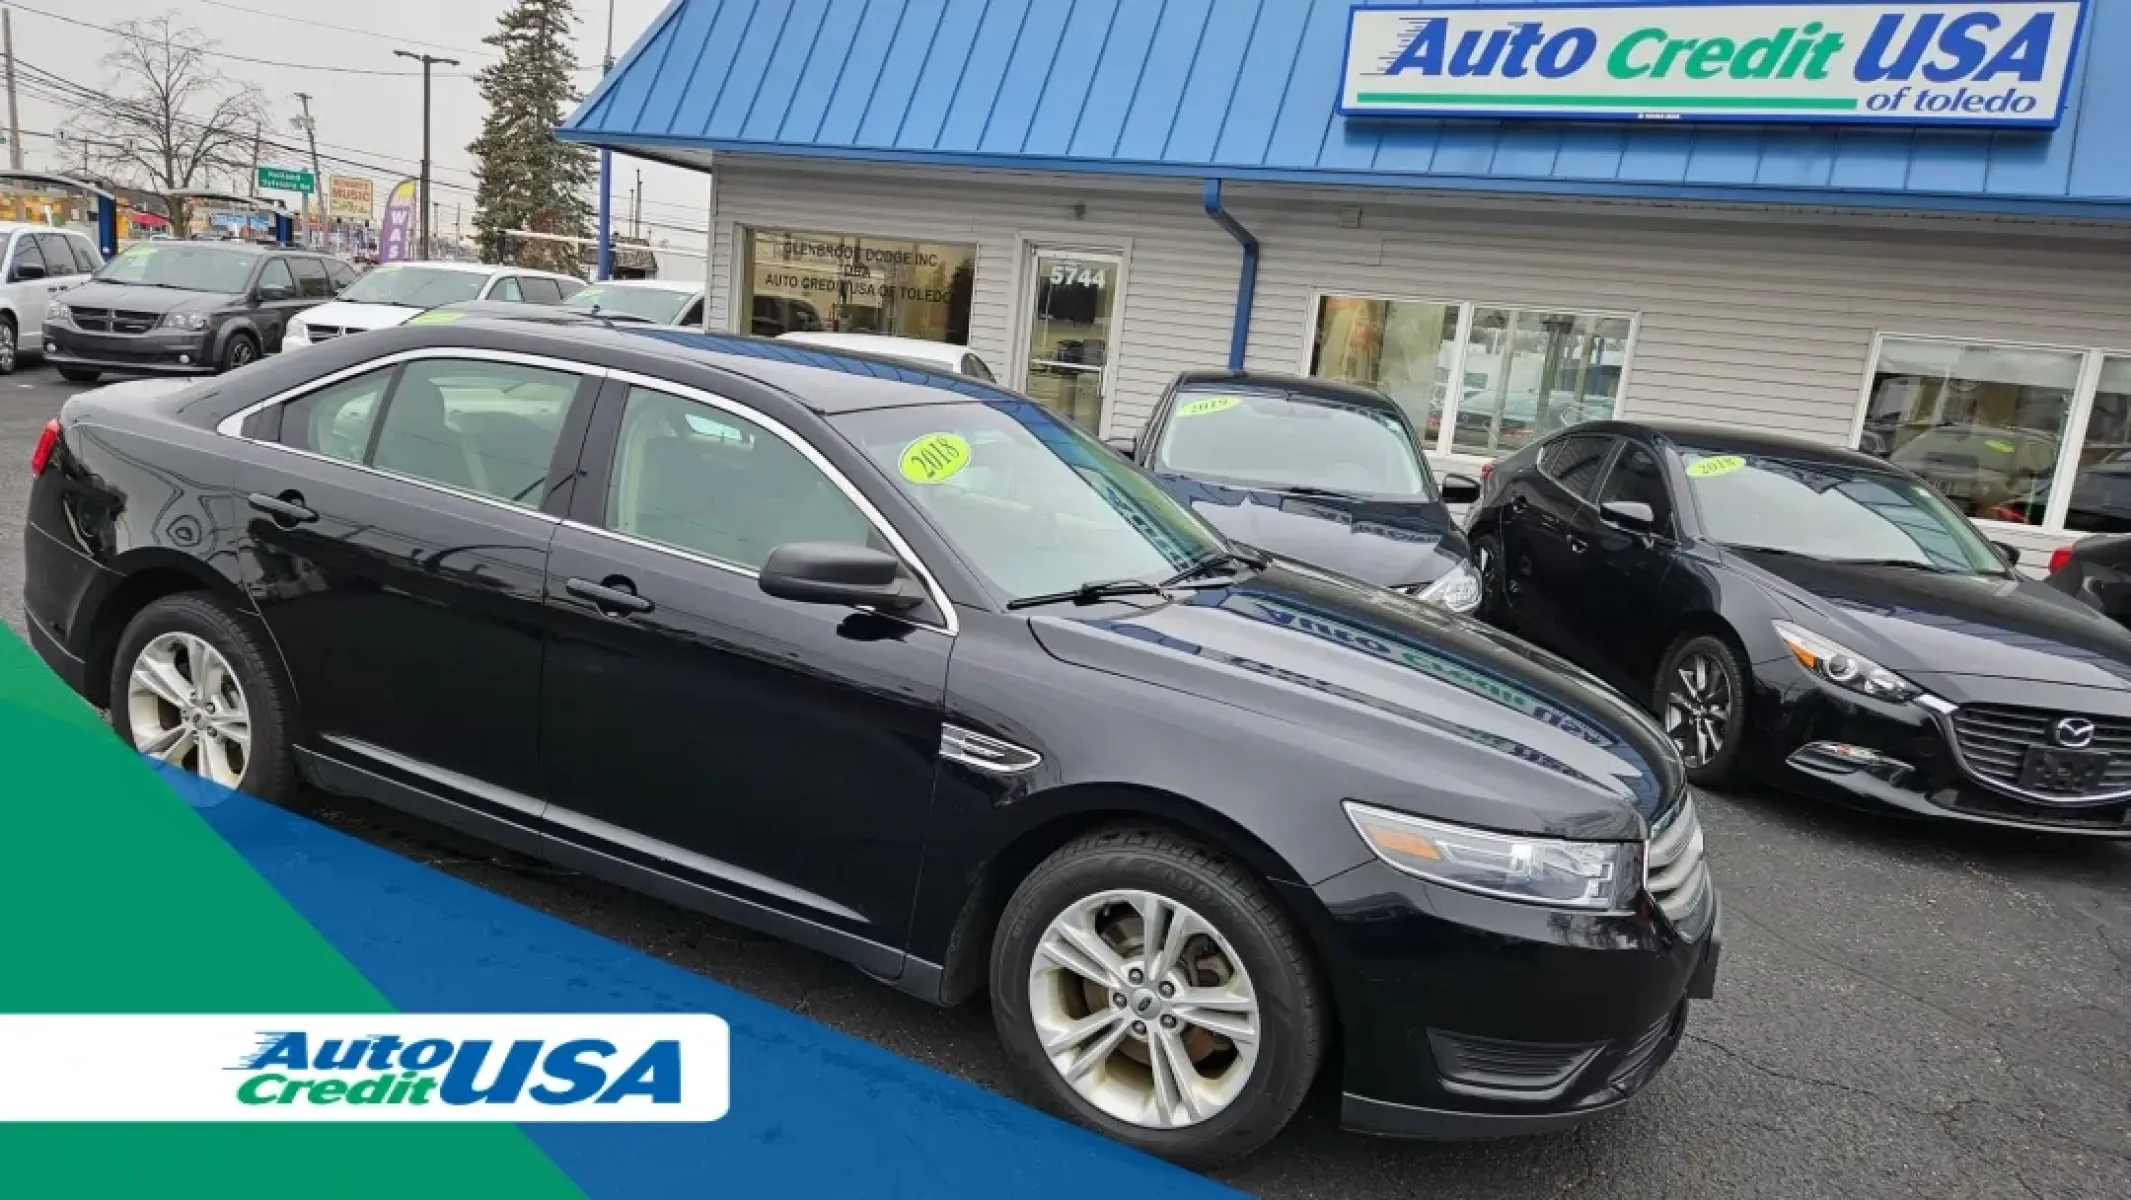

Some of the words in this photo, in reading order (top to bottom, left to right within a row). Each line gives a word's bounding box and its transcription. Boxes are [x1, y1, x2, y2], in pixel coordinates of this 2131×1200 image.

[1362, 17, 1597, 79] Auto
[1606, 20, 1845, 80] Credit
[1853, 11, 2056, 83] USA
[1866, 86, 1911, 112] of
[1914, 87, 2037, 113] toledo
[332, 187, 370, 202] MUSIC
[783, 242, 861, 262] GLENBROO
[866, 248, 911, 265] DODGE
[914, 253, 938, 267] INC
[765, 273, 798, 288] AUTO
[800, 276, 851, 294] CREDI
[851, 281, 875, 296] USA
[1050, 265, 1106, 289] 5744
[910, 435, 960, 479] 2018
